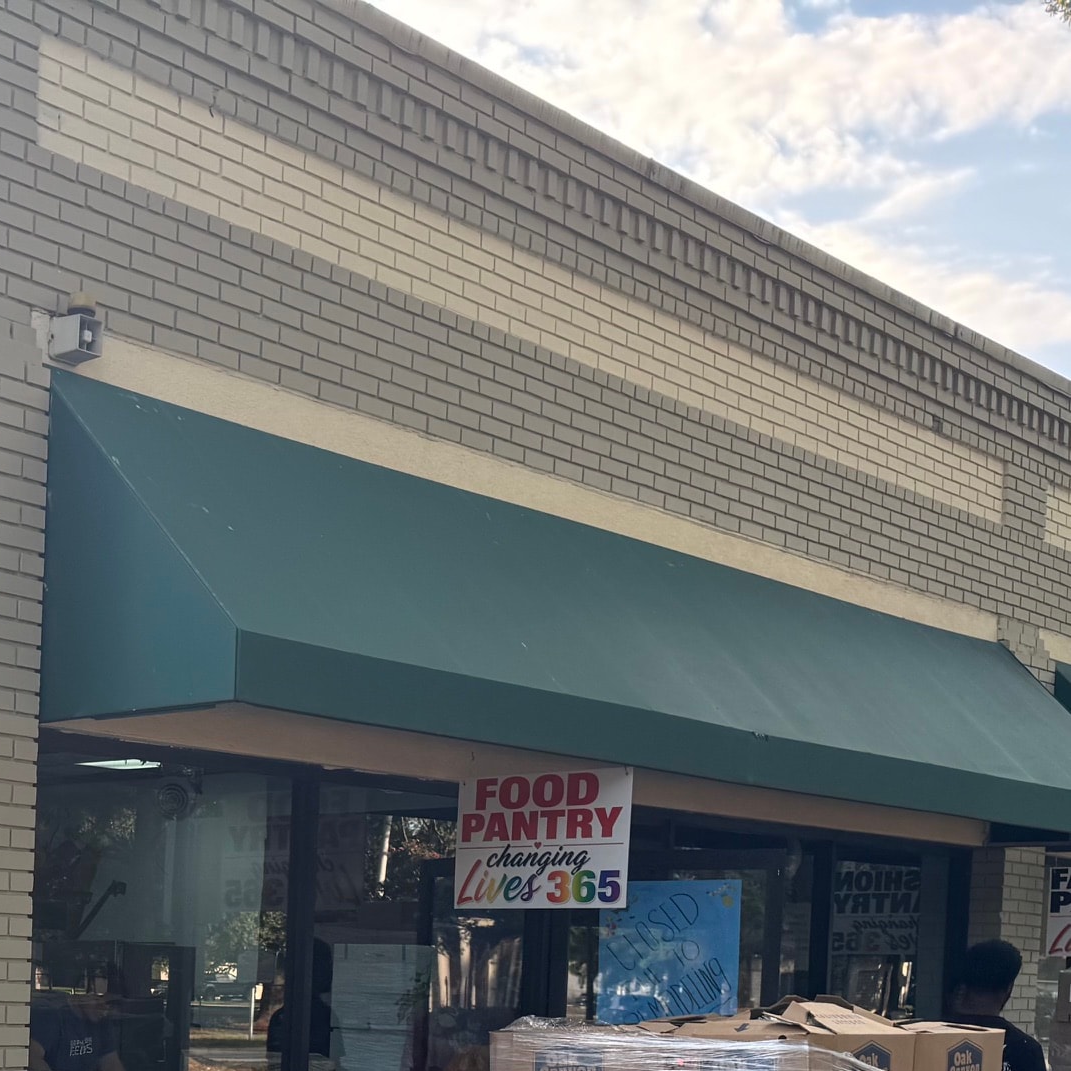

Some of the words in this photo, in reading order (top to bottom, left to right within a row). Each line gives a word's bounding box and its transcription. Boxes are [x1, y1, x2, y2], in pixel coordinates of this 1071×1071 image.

[475, 772, 600, 811] FOOD
[461, 806, 624, 843] PANTRY
[486, 843, 591, 876] changing
[457, 859, 542, 905] Lives
[546, 869, 621, 904] 365
[606, 893, 699, 971] CLOSED
[954, 1049, 973, 1065] Oak
